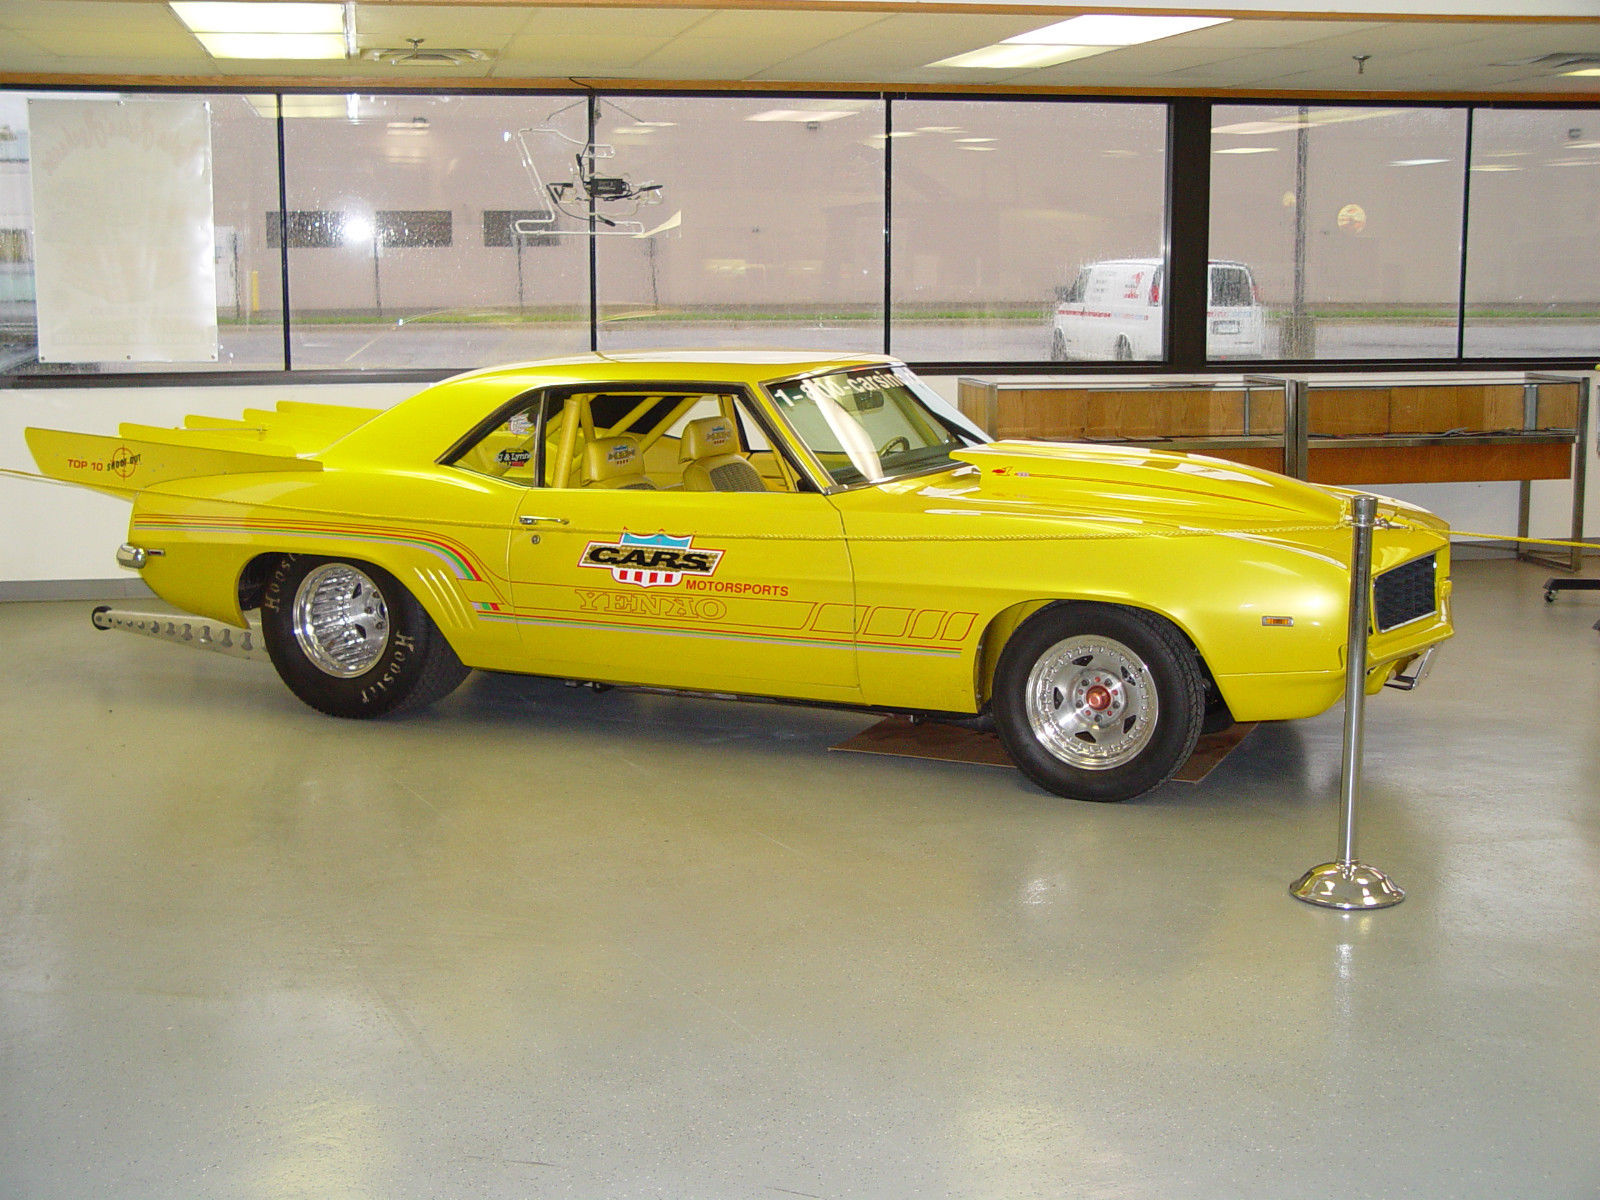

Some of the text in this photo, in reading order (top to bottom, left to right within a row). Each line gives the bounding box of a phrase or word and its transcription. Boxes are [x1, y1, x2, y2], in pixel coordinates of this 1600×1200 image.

[67, 459, 88, 470] TOP
[91, 462, 103, 472] 10
[686, 579, 789, 597] MOTORSPORTS
